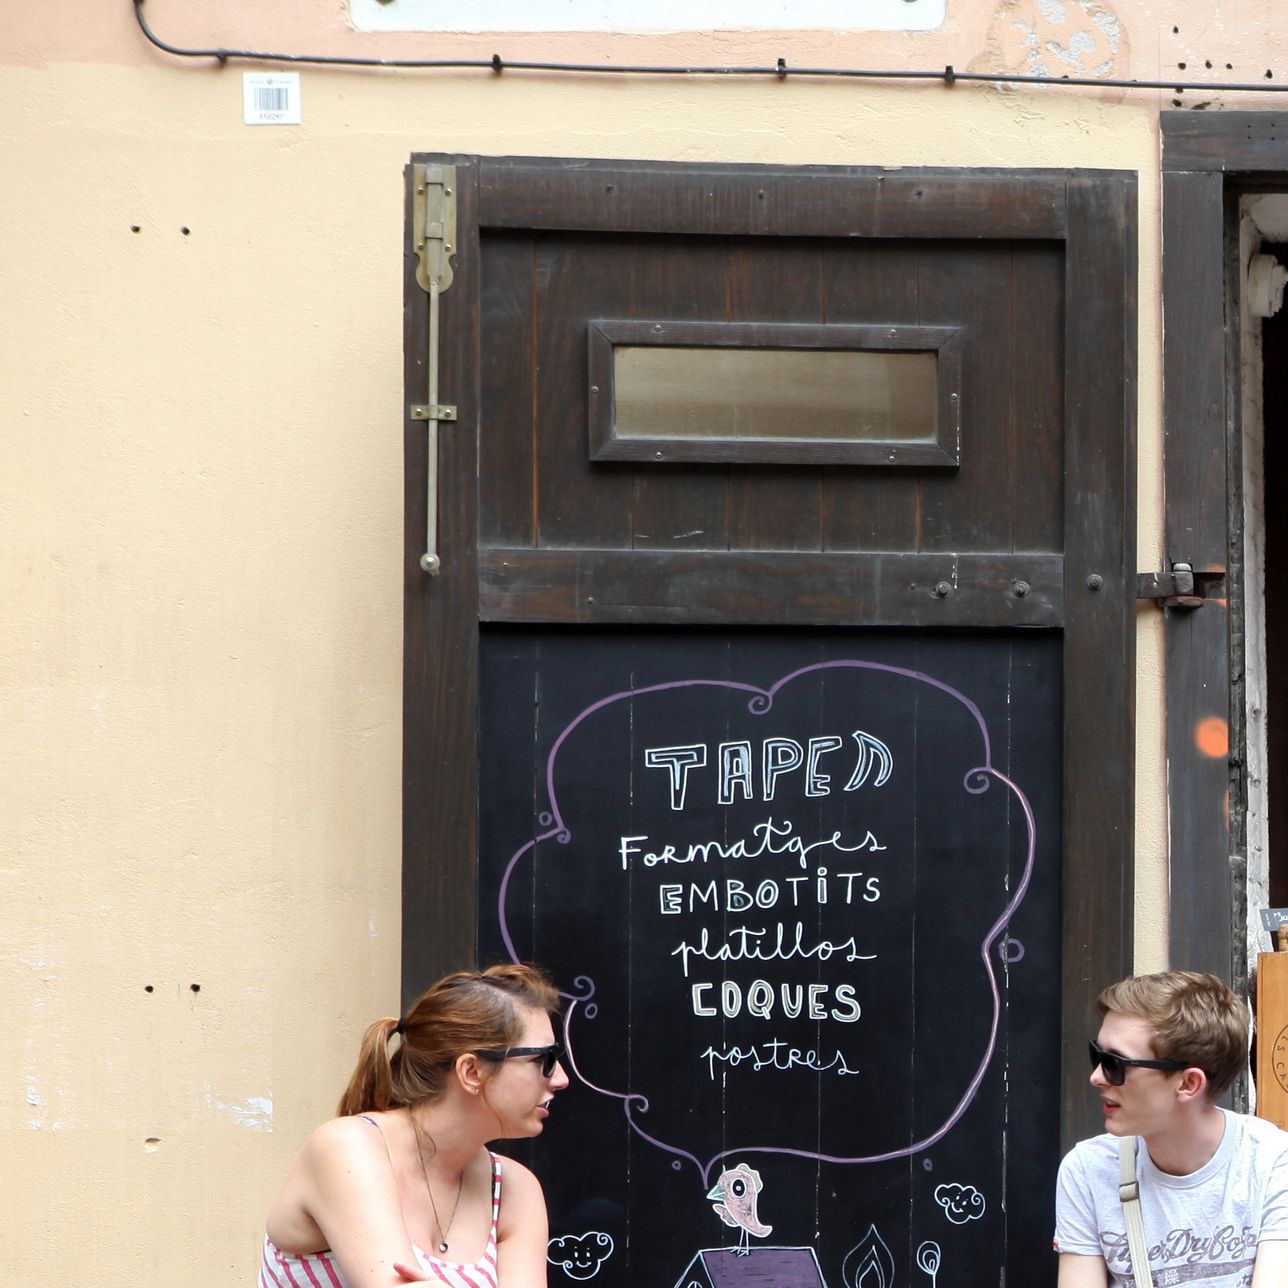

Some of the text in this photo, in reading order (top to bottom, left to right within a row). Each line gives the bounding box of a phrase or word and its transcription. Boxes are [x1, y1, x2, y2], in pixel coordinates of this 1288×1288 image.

[645, 730, 893, 810] TAPES
[672, 922, 877, 977] platillos
[692, 980, 861, 1022] COQUES
[701, 1037, 859, 1080] postres
